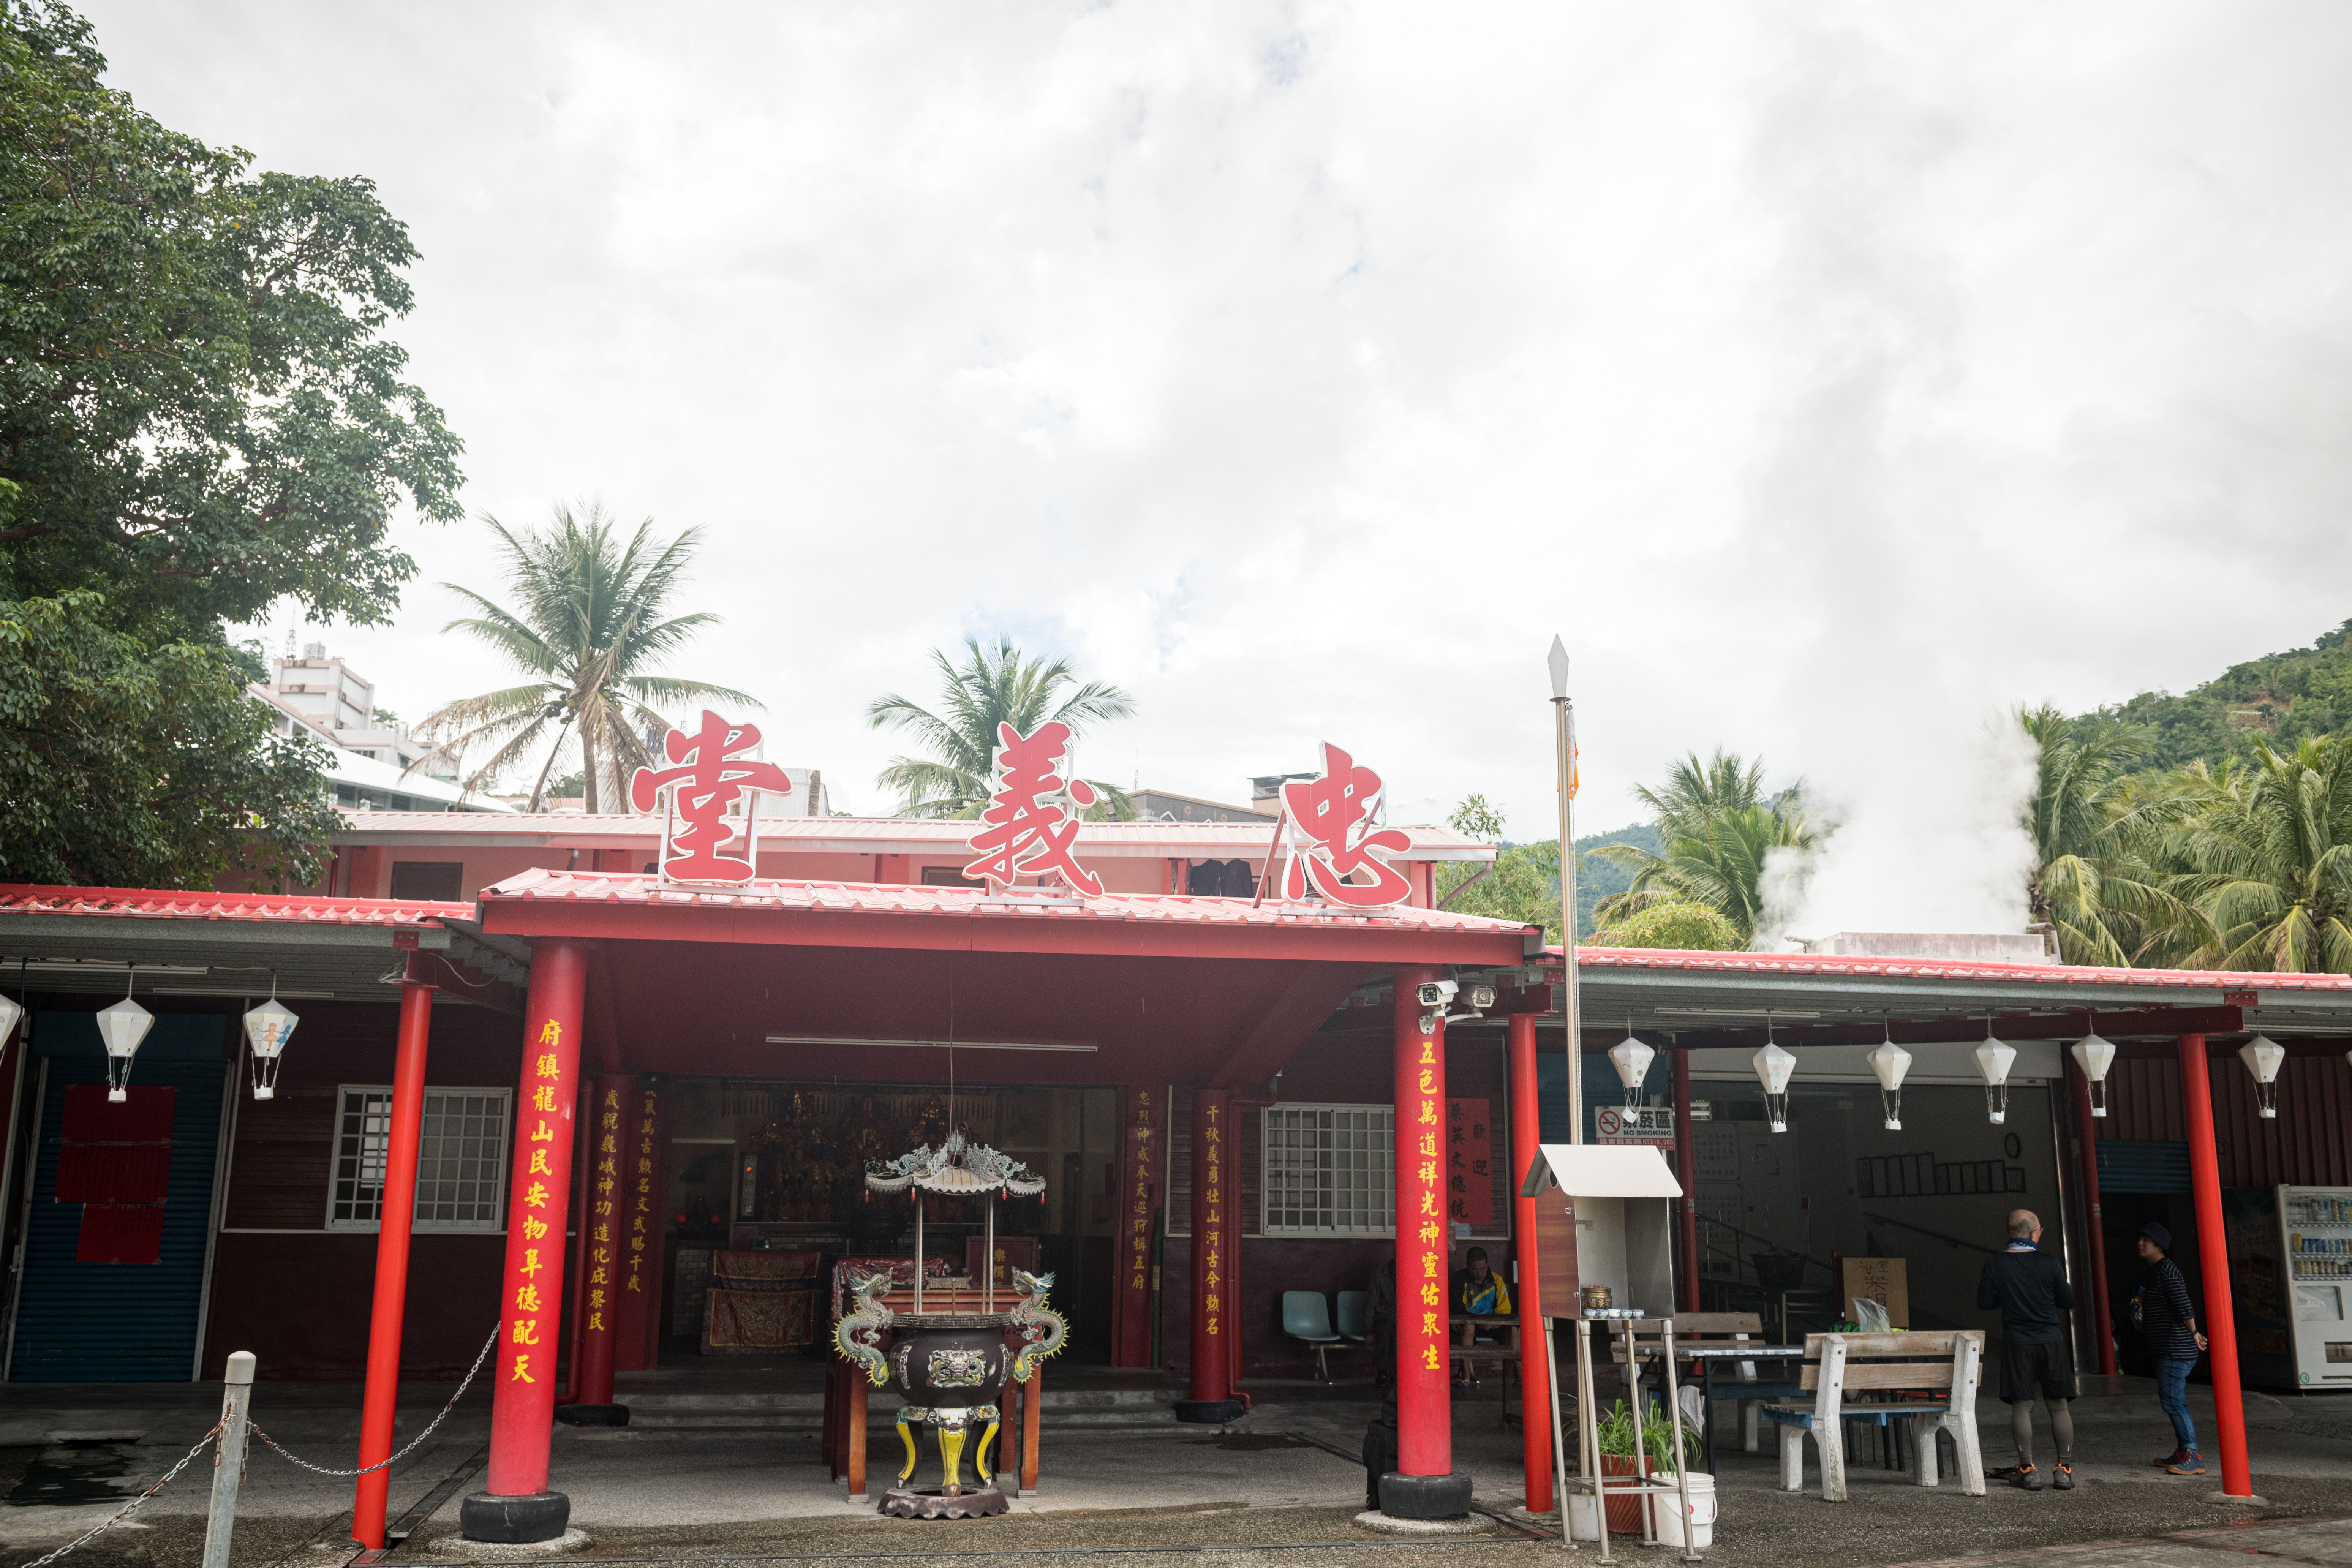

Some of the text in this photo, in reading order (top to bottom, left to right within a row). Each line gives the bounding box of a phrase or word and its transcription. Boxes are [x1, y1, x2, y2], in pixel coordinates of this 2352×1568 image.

[631, 709, 1412, 907] 忠義堂
[511, 1019, 562, 1383] 府鎮龍山民安物阜德配天
[1418, 1042, 1441, 1370] 五色萬道祥光神靈佑眾生
[1449, 1103, 1468, 1218] 蔡英文總統
[1472, 1123, 1489, 1177] 歡迎
[1859, 1260, 1889, 1274] 浴室
